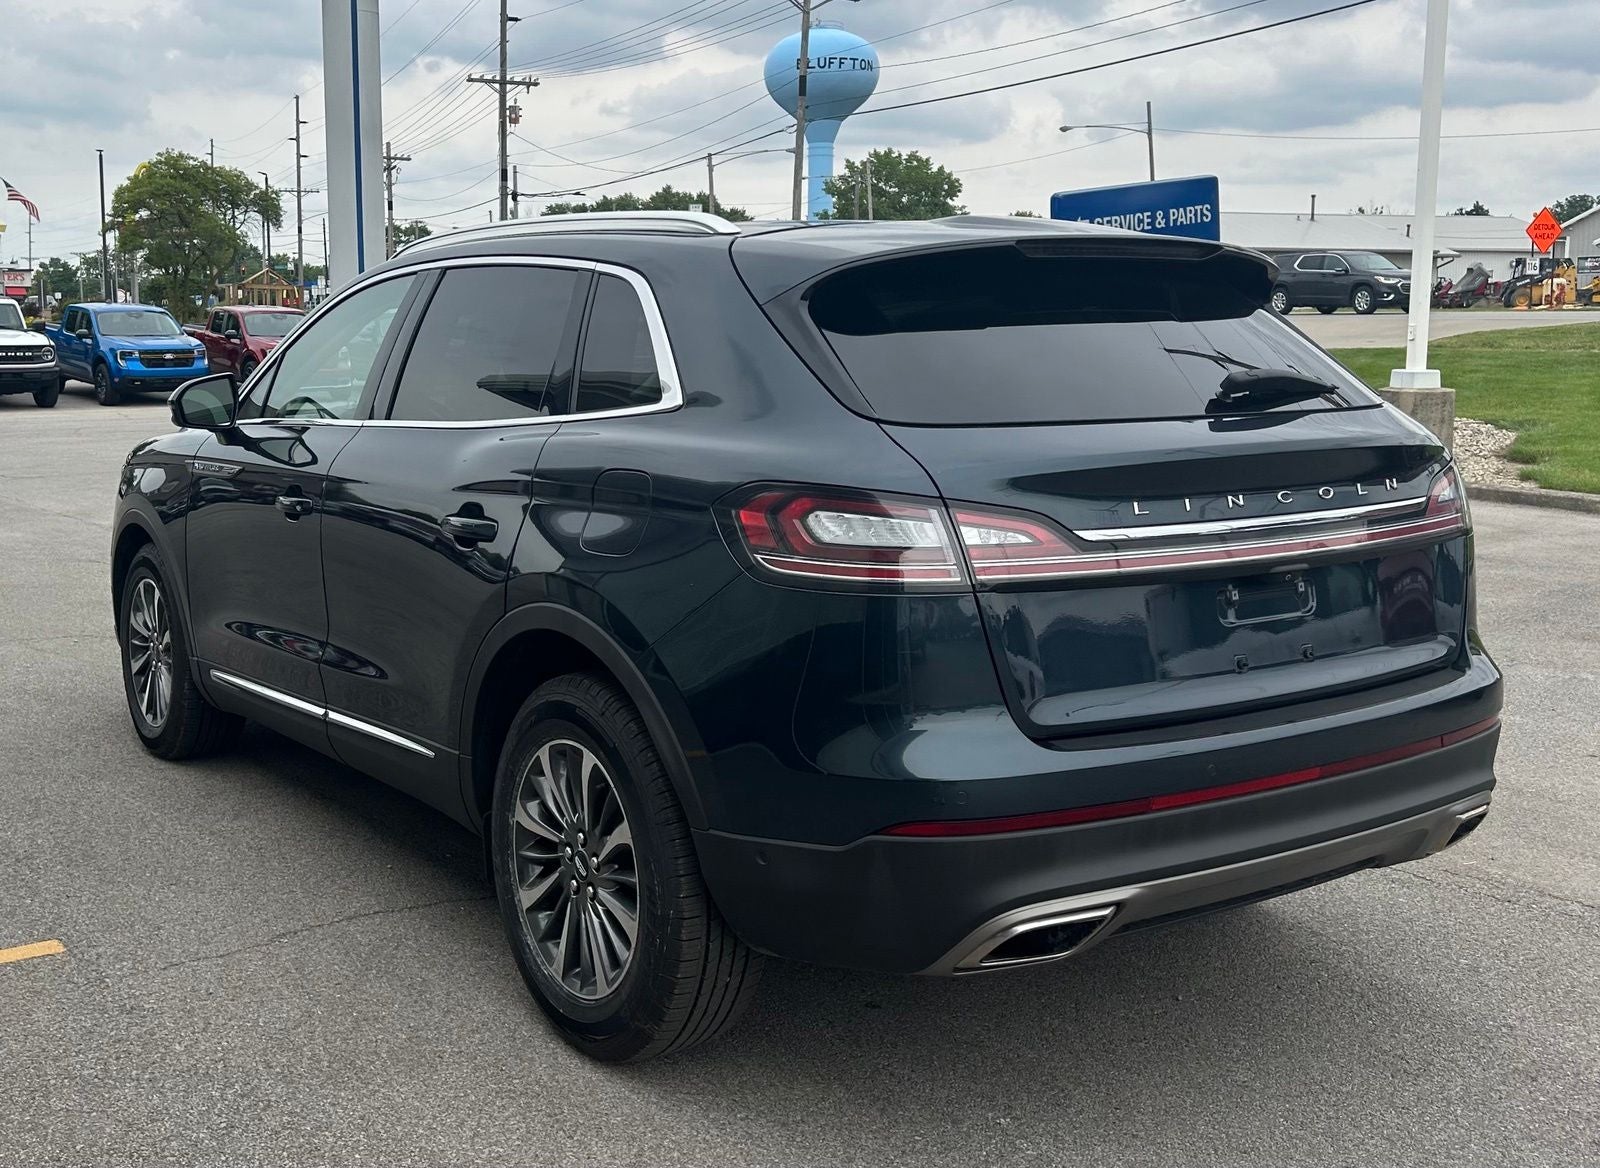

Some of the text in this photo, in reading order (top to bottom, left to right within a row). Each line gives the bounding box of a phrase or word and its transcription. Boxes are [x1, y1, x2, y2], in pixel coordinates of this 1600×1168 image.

[1155, 210, 1166, 229] &
[1169, 204, 1212, 227] PARTS
[1533, 223, 1556, 231] DETOUR
[1534, 233, 1555, 241] AHEAD
[1527, 262, 1538, 271] 116
[1133, 477, 1398, 515] LINCOLN
